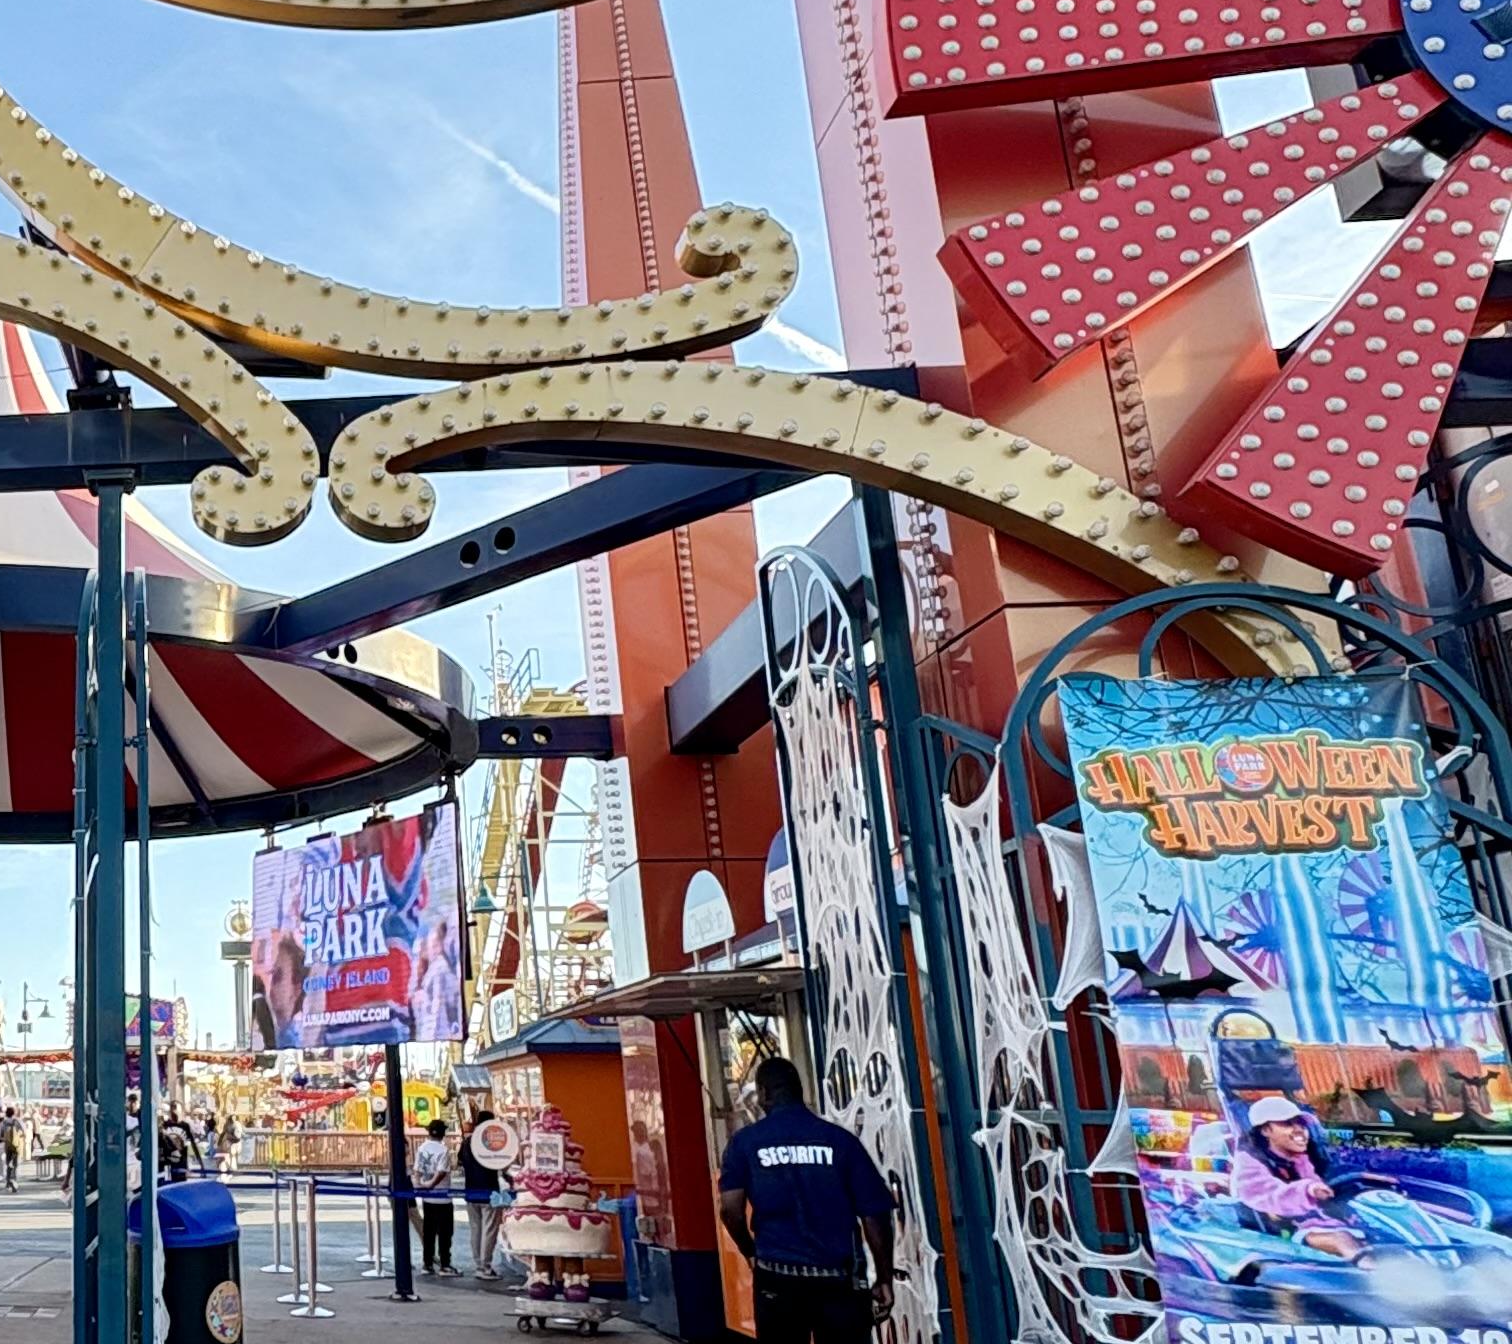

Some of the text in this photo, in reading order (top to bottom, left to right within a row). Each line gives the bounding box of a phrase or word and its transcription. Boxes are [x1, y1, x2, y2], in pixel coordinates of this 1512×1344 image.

[1150, 794, 1375, 853] HARVEST
[304, 855, 389, 916] LUNA
[304, 908, 390, 967] PARK
[302, 967, 391, 993] CONEY ISLAND
[302, 1006, 391, 1027] LUNAPARKNYC.COM
[757, 1145, 834, 1167] SECURITY
